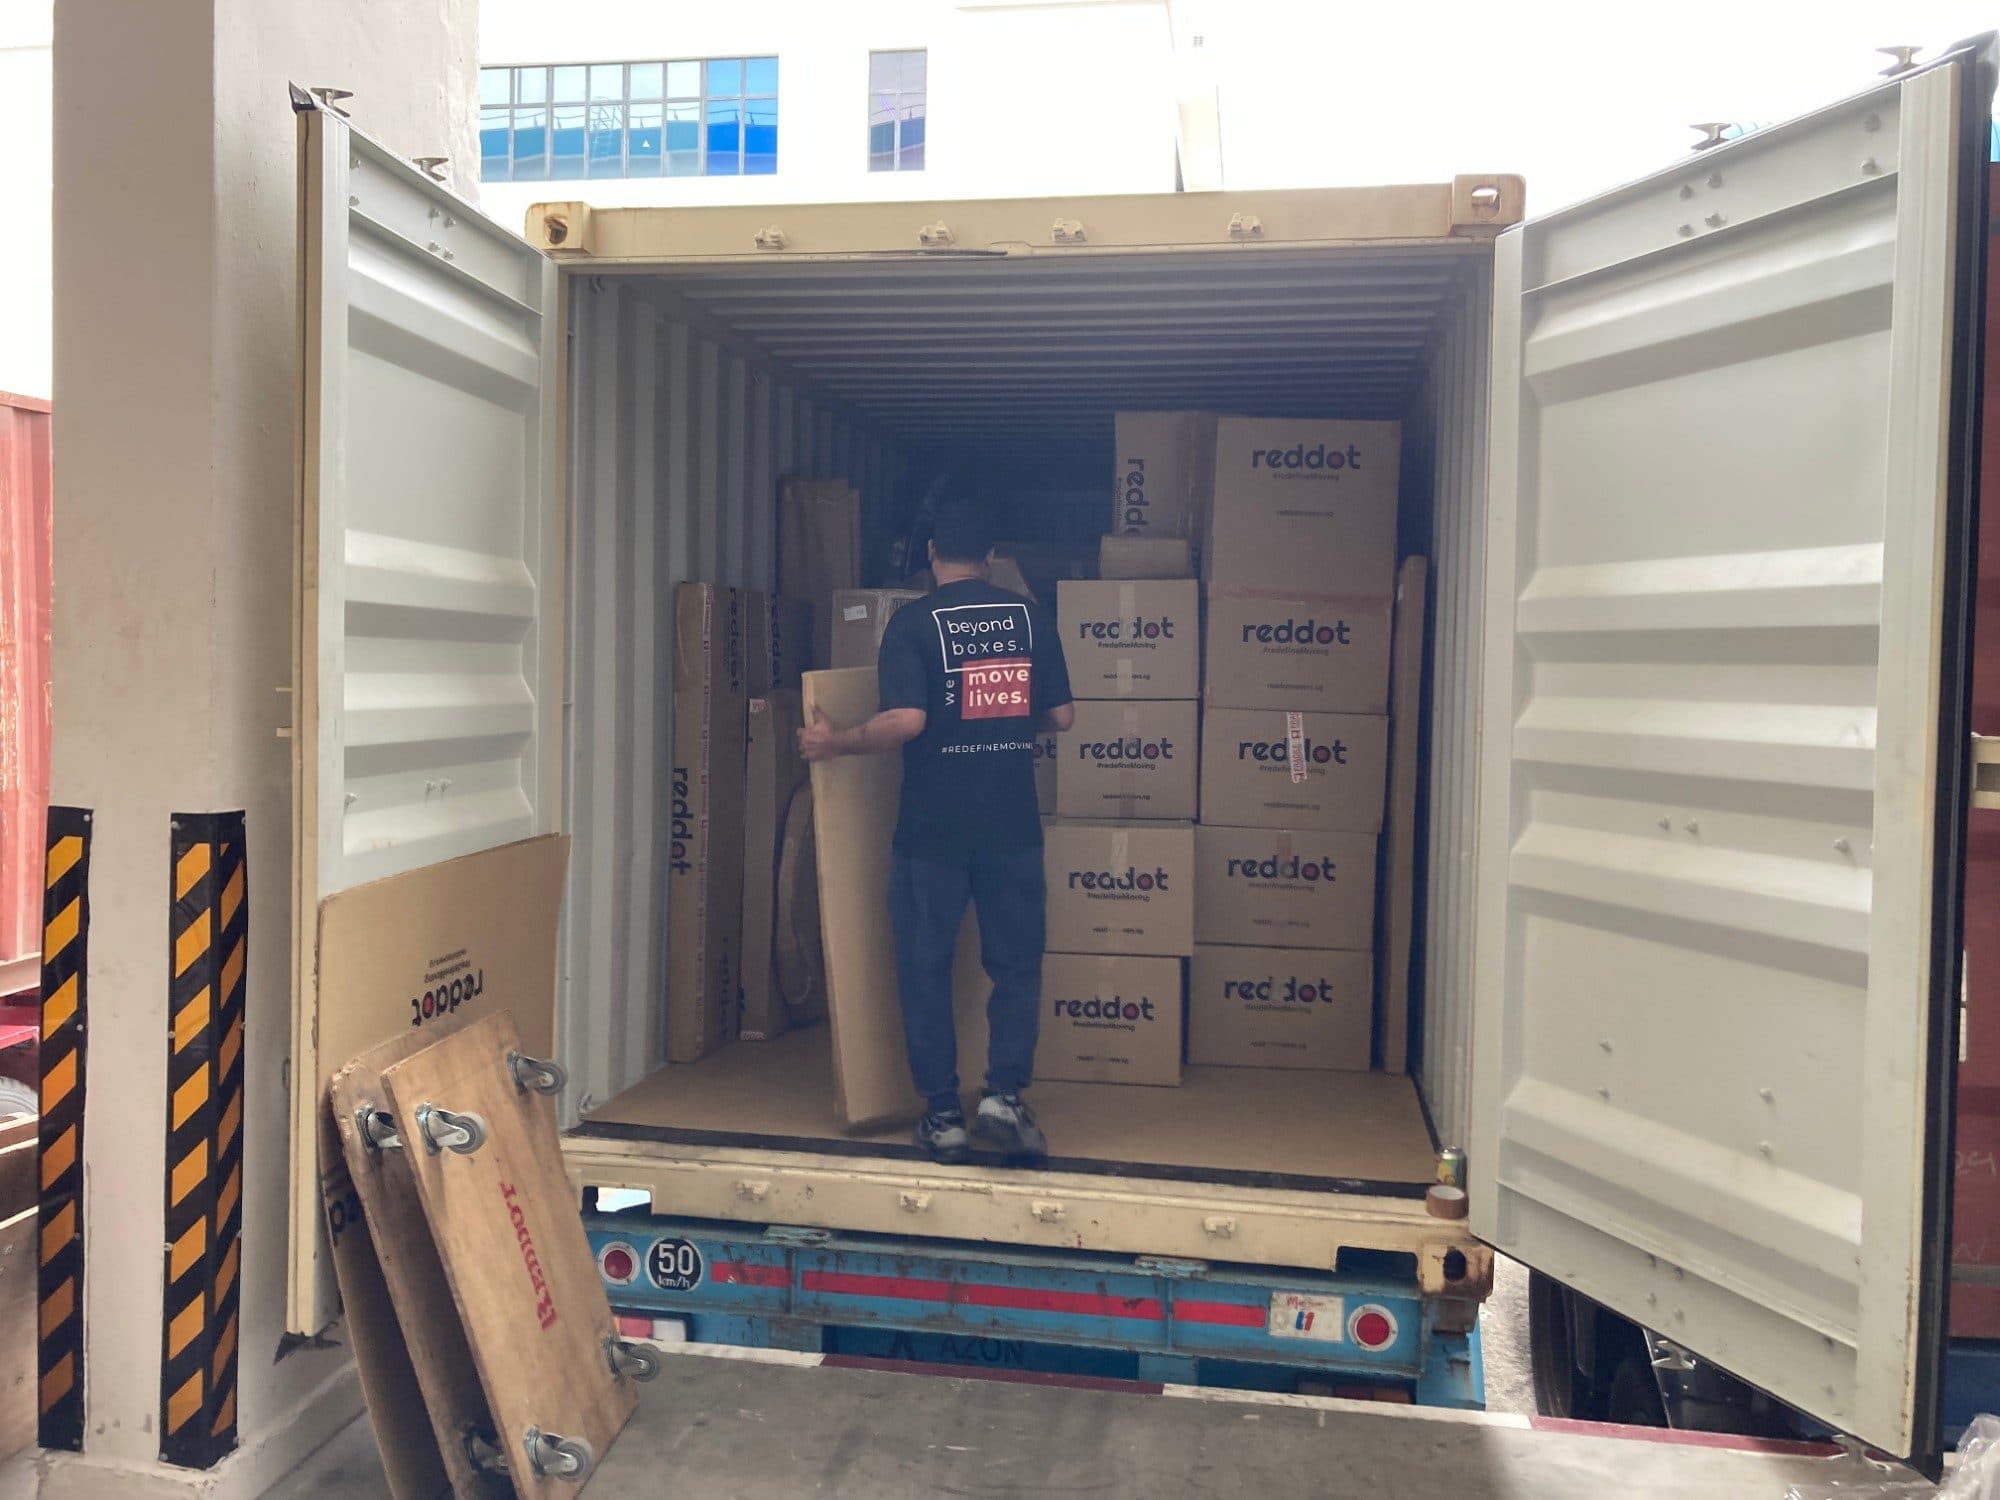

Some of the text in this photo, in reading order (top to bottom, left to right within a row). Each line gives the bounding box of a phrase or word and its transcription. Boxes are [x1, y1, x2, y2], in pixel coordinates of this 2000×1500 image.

[1252, 443, 1361, 470] reddot
[946, 616, 1014, 636] beyond
[1242, 618, 1351, 645] reddot
[952, 638, 1024, 655] boxes.
[968, 669, 1029, 686] move
[945, 679, 955, 705] we
[968, 689, 1028, 707] lives.
[1079, 737, 1173, 760] reddot
[672, 767, 694, 875] reddot
[1227, 854, 1336, 882] reddot
[410, 968, 484, 1027] reddot
[1054, 995, 1155, 1022] reddot
[658, 1243, 694, 1275] 50
[658, 1274, 691, 1289] km/h
